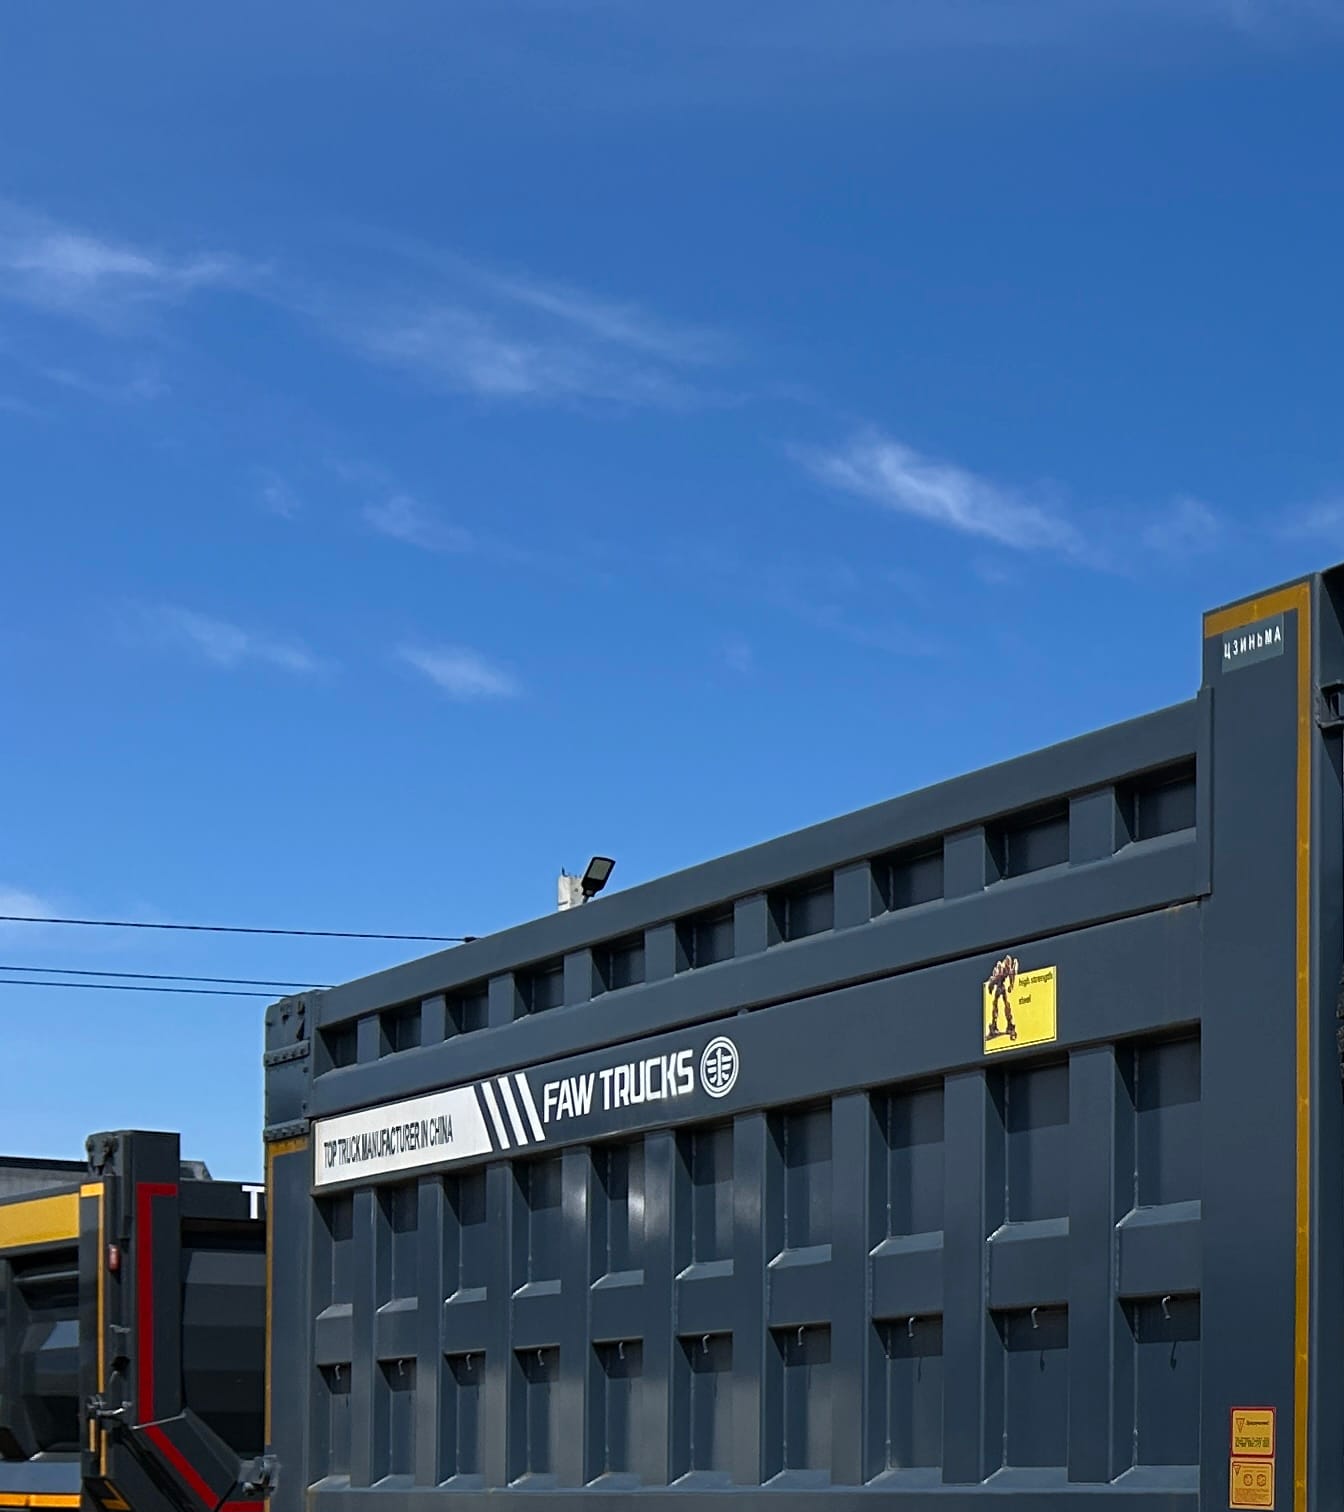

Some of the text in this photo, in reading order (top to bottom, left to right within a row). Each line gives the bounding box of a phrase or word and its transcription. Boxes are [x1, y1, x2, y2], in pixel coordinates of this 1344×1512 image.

[1223, 625, 1282, 660] ЦЗИНЬМА
[543, 1049, 694, 1123] FAW TRUCKS
[324, 1114, 454, 1168] TOP TRUCK MANUFACTURER IN CHINA
